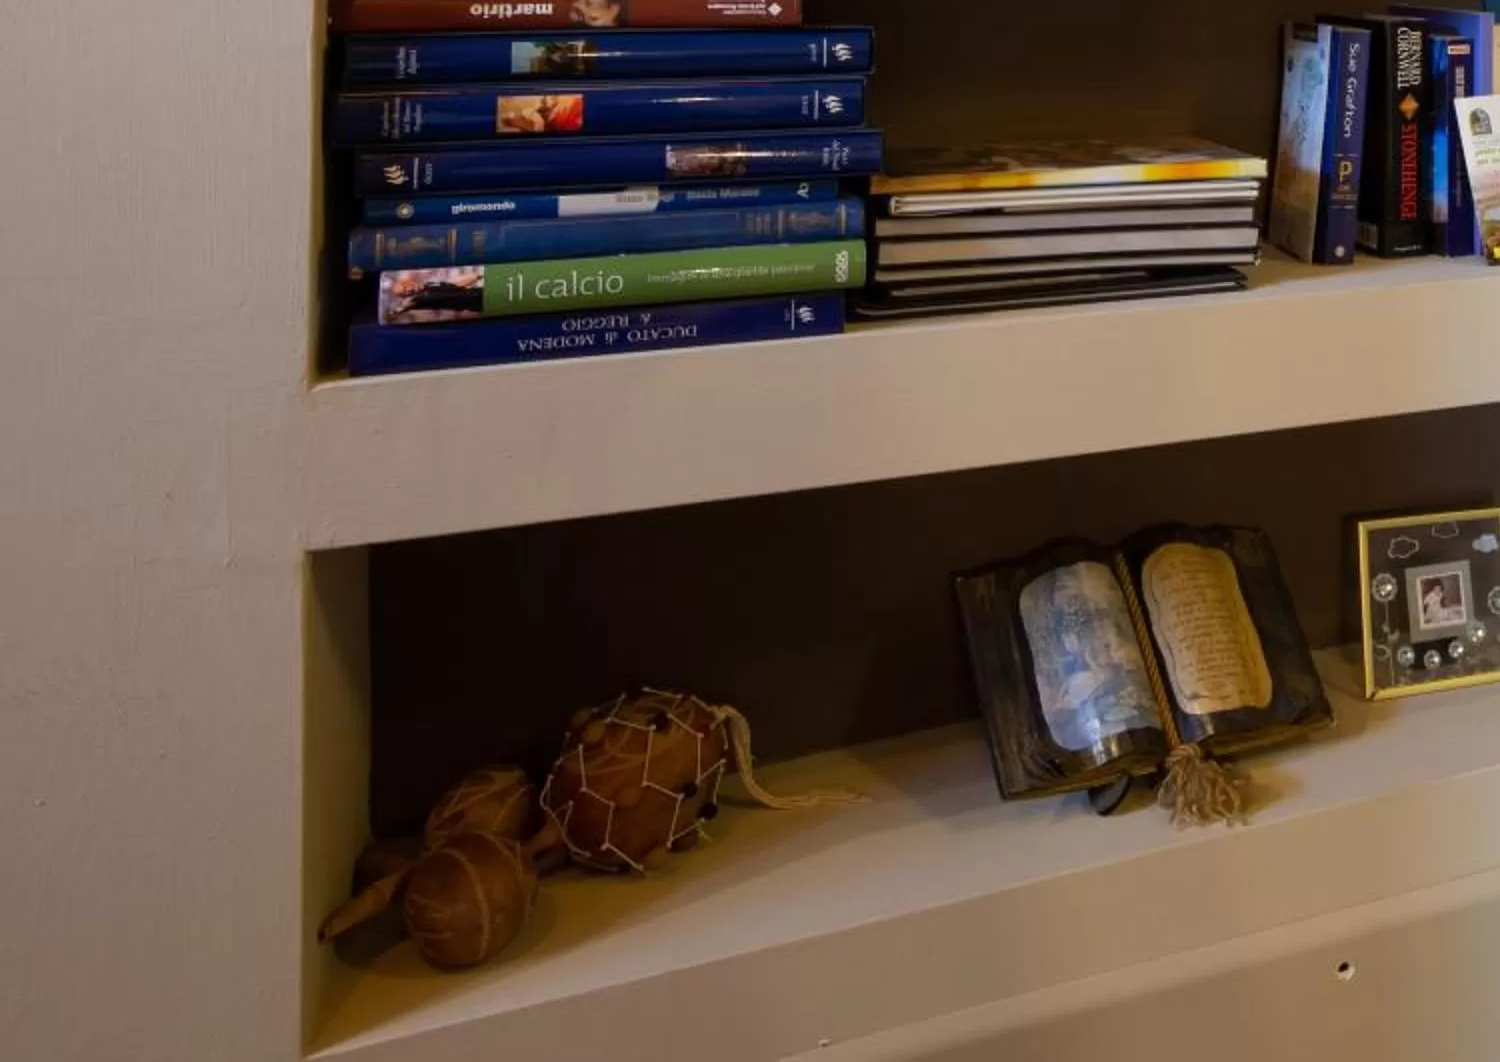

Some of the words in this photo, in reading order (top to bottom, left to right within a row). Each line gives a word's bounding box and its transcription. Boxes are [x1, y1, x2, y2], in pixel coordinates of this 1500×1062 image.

[469, 2, 554, 20] martirio
[1346, 42, 1361, 73] Sue
[1396, 26, 1411, 90] CORNWELL
[1409, 30, 1423, 86] BERNARD
[1342, 76, 1358, 140] Grafton
[1339, 160, 1353, 183] P
[1399, 122, 1418, 221] STONEHENGE
[506, 270, 524, 302] il
[535, 269, 625, 300] calcio
[560, 313, 630, 331] REGGIO
[626, 323, 697, 344] DUCATO
[516, 334, 597, 353] MODENA
[604, 330, 619, 346] di
